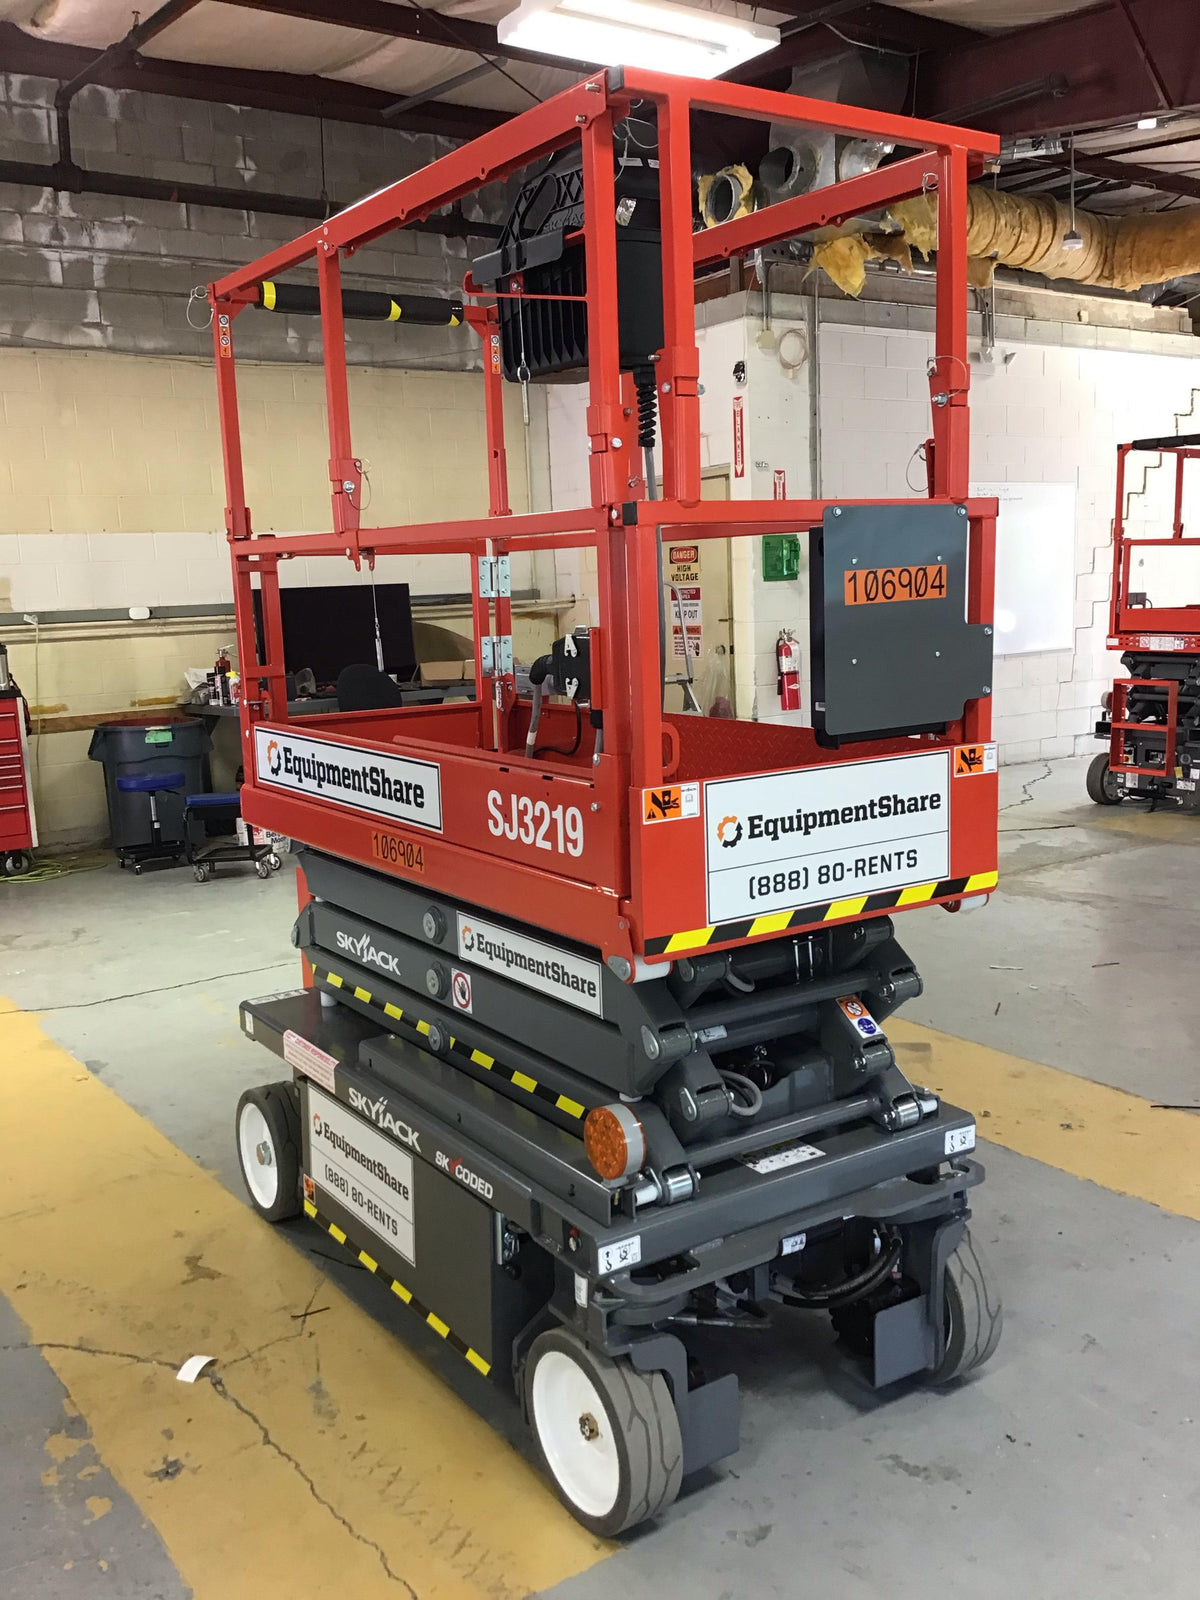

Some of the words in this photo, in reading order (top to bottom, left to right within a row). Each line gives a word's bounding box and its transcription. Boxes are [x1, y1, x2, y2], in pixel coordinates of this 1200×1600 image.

[671, 572, 699, 581] VOLTAGE
[672, 550, 695, 560] DANGER
[677, 564, 692, 572] HIGH
[847, 566, 945, 602] 106904
[687, 609, 698, 618] OUT
[283, 746, 424, 808] EquipmentShare
[487, 789, 584, 857] SJ3219
[748, 793, 941, 841] EquipmentShare
[373, 832, 424, 872] 106904
[749, 867, 809, 899] (888)
[818, 849, 918, 884] 80-RENTS
[336, 930, 401, 976] SKYJACK
[476, 932, 597, 998] EquipmentShare
[348, 1086, 422, 1153] SKYJACK
[323, 1121, 409, 1201] EquipmentShare
[435, 1150, 494, 1200] SKYCODED
[324, 1164, 349, 1198] (888)
[351, 1186, 398, 1237] 80-RENTS
